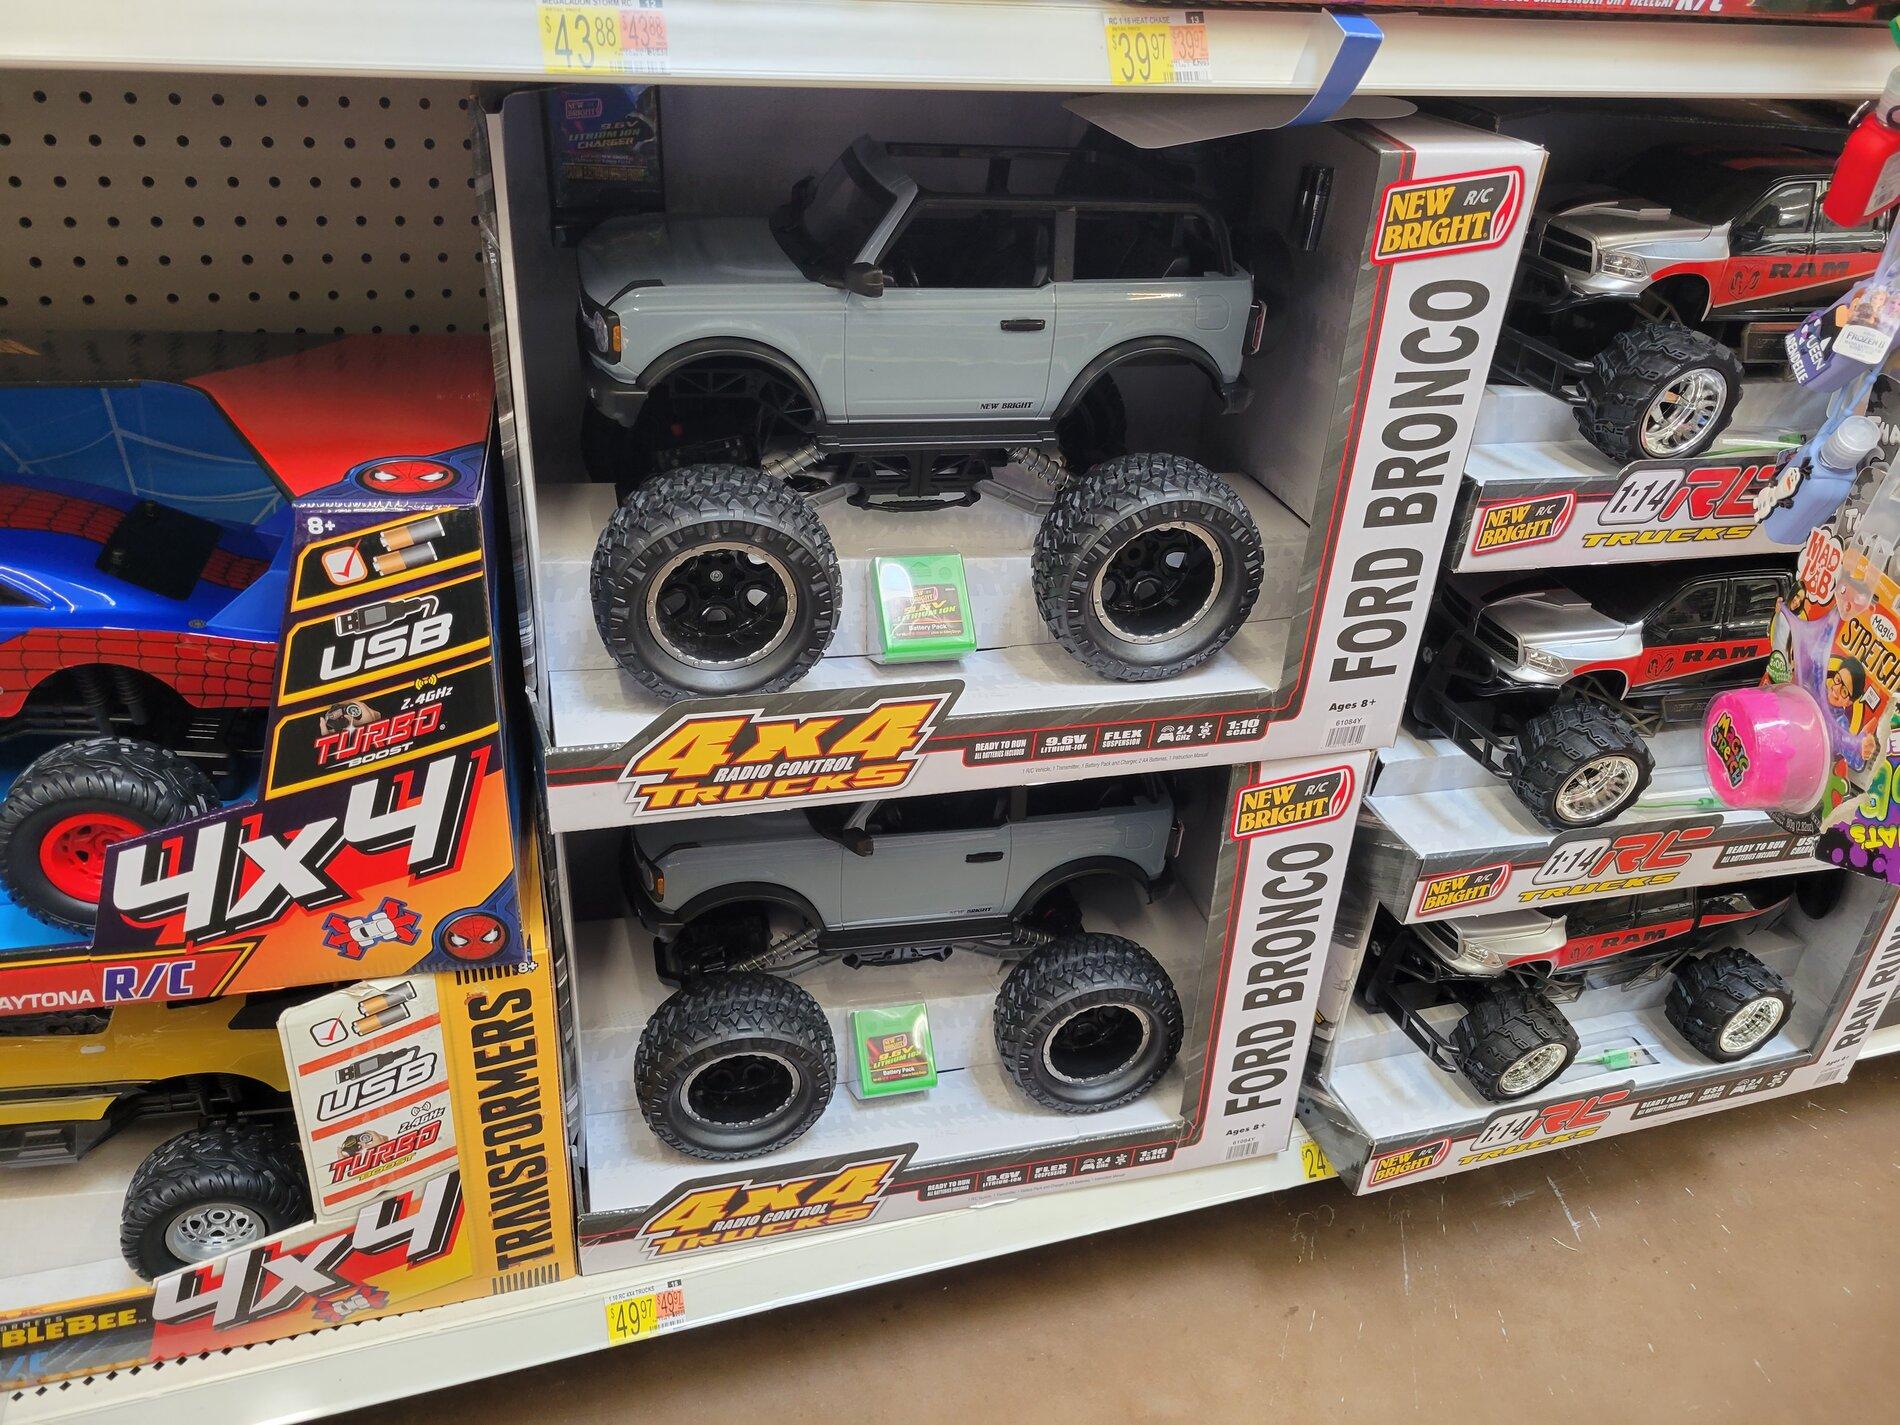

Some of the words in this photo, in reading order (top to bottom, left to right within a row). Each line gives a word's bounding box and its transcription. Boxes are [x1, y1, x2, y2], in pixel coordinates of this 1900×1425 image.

[1149, 16, 1171, 24] CHASE
[577, 137, 634, 149] CHARGER
[1387, 185, 1456, 222] NEW
[1463, 187, 1494, 206] R/C
[1381, 211, 1491, 253] BRIGHT
[1768, 261, 1850, 279] RAM
[1845, 331, 1880, 348] FROZEN
[1785, 333, 1809, 385] ARENDELLE
[980, 402, 1000, 410] NEW
[1001, 401, 1034, 410] BRIGHT
[1363, 279, 1491, 529] BRONCO
[1610, 478, 1672, 514] 1:14
[307, 516, 336, 536] 8+
[1485, 504, 1532, 528] NEW
[1535, 503, 1556, 516] R/C
[1479, 518, 1553, 547] BRIGHT
[1582, 524, 1758, 549] TRUCKS
[1805, 530, 1842, 573] MAD
[1801, 559, 1833, 601] LAB
[938, 604, 957, 614] ION
[1329, 547, 1424, 683] FORD
[908, 624, 931, 632] Battery
[1872, 615, 1895, 642] Magic
[319, 612, 454, 681] USB
[1681, 646, 1758, 664] RAM
[1840, 617, 1900, 693] STRETCH
[400, 684, 454, 711] 2.4GHz
[1328, 702, 1358, 713] Ages
[1360, 699, 1376, 708] 8+
[314, 702, 443, 766] TURBO
[1176, 725, 1193, 735] 2.4
[1226, 727, 1258, 737] SCALE
[1227, 717, 1260, 730] 1:10
[975, 741, 999, 752] READY
[1000, 740, 1009, 750] TO
[1009, 738, 1027, 749] RUN
[1045, 734, 1087, 747] 9.6V
[1102, 737, 1141, 748] SUSPENSION
[1104, 729, 1143, 741] FLEX
[1175, 733, 1191, 742] GHz
[347, 741, 415, 768] BOOST
[974, 751, 983, 760] ALL
[982, 750, 1004, 759] BATTERIES
[1004, 748, 1025, 757] INCLUDED
[1040, 743, 1088, 754] LITHIUM-ION
[713, 765, 771, 783] RADIO
[774, 756, 855, 777] CONTROL
[639, 761, 912, 811] TRUCKS
[1241, 783, 1299, 811] NEW
[1304, 780, 1329, 796] R/C
[1238, 797, 1329, 833] BRIGHT
[1720, 855, 1731, 864] ALL
[1730, 853, 1756, 863] BATTERIES
[1756, 850, 1780, 861] INCLUDED
[1726, 843, 1754, 855] READY
[1755, 841, 1767, 852] TO
[1768, 839, 1787, 851] RUN
[1543, 846, 1600, 879] 1:14
[1429, 875, 1470, 893] NEW
[1475, 872, 1493, 883] R/C
[1518, 872, 1680, 902] TRUCKS
[1423, 885, 1490, 911] BRIGHT
[1241, 842, 1334, 1012] BRONCO
[1600, 928, 1667, 949] RAM
[517, 960, 539, 974] 8+
[102, 960, 197, 1002] R/C
[1832, 990, 1886, 1052] RAM
[873, 1054, 907, 1069] LITHIUM
[878, 1045, 915, 1062] 9.6V
[882, 1068, 901, 1077] Battery
[1224, 1018, 1297, 1116] FORD
[317, 1052, 438, 1122] USB
[1698, 1091, 1723, 1102] CHARGE
[1702, 1084, 1726, 1096] USB
[1641, 1099, 1664, 1109] READY
[1666, 1096, 1677, 1104] TO
[1678, 1092, 1695, 1101] RUN
[397, 1107, 447, 1134] 2.4GHz
[467, 986, 555, 1271] TRANSFORMERS
[1226, 1126, 1250, 1136] Ages
[1253, 1123, 1266, 1131] 8+
[1480, 1115, 1533, 1145] 1:14
[328, 1120, 442, 1184] TURBO
[1457, 1125, 1602, 1167] TRUCKS
[1035, 1163, 1068, 1174] FLEX
[1374, 1156, 1432, 1182] BRIGHT
[1377, 1152, 1412, 1170] NEW
[982, 1176, 1023, 1188] LITHIUM-ION
[985, 1171, 1022, 1184] 9.6V
[1033, 1168, 1067, 1179] SUSPENSION
[927, 1181, 948, 1192] READY
[948, 1180, 957, 1189] TO
[957, 1178, 971, 1187] RUN
[650, 1202, 880, 1255] TRUCKS
[712, 1216, 758, 1233] RADIO
[761, 1203, 830, 1224] CONTROL
[635, 1285, 655, 1295] TRUCKS
